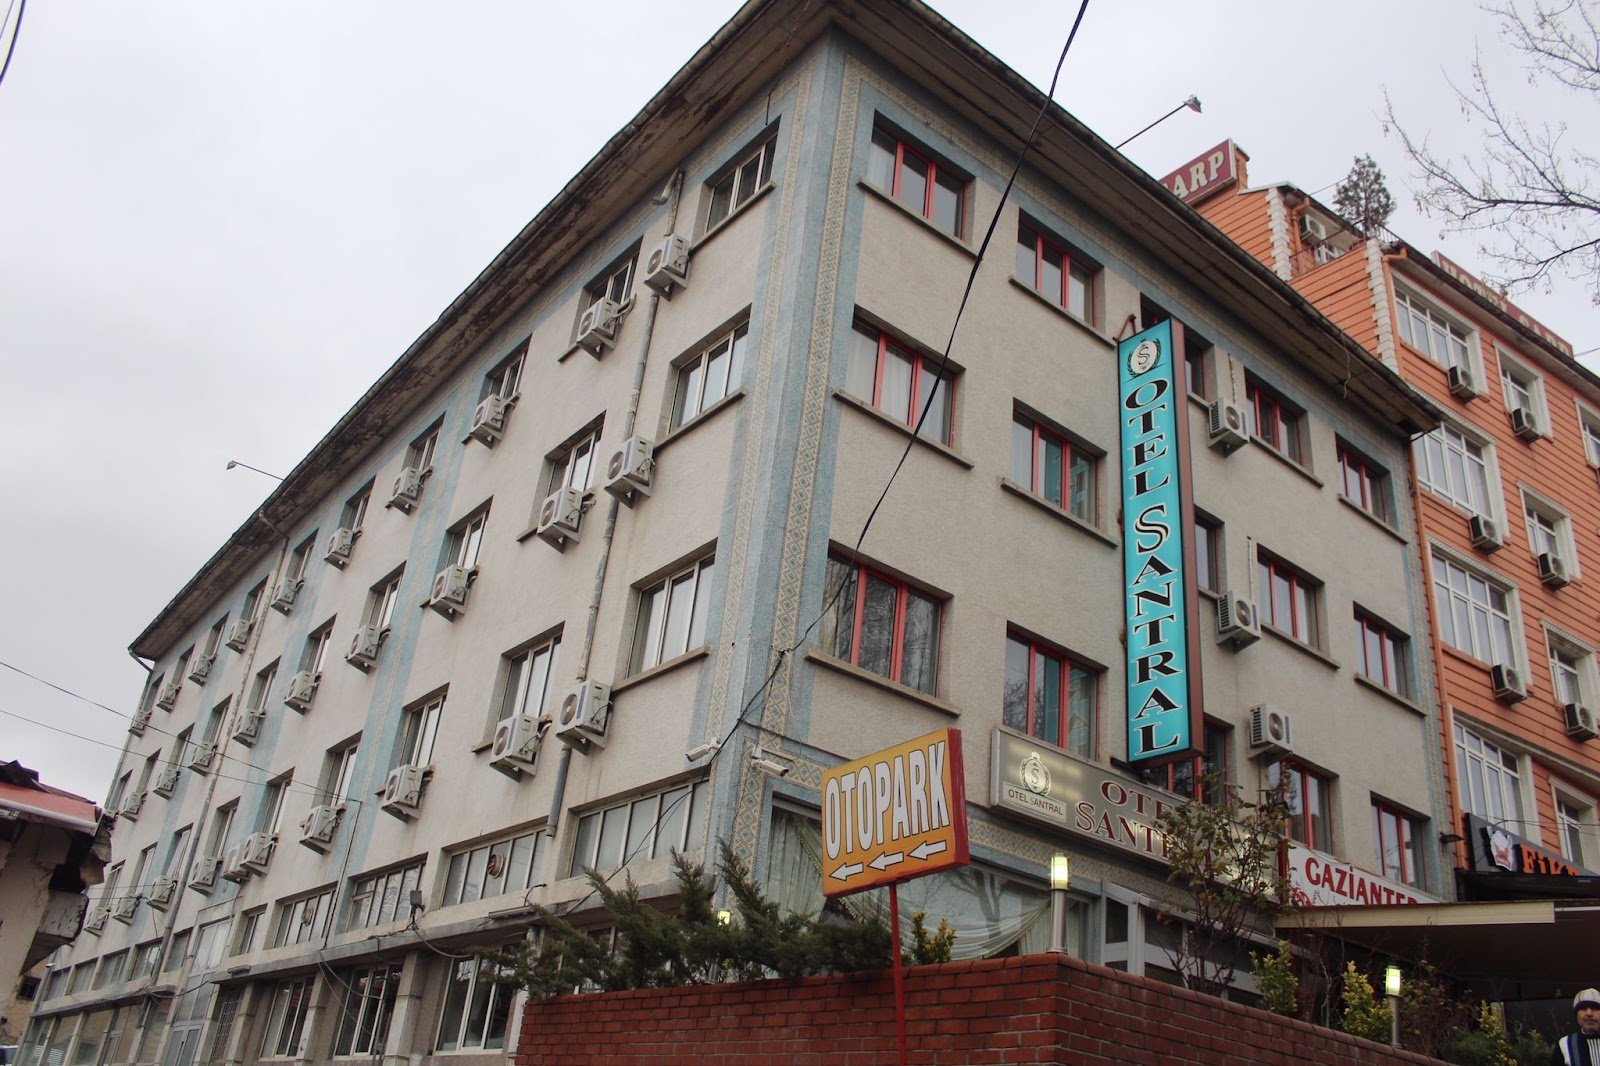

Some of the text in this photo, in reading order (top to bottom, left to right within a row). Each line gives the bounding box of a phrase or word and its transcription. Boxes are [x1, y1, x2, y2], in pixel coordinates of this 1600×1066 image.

[1163, 150, 1225, 199] ARP
[1124, 378, 1184, 756] OTEL SANTRAL
[825, 740, 950, 861] OTOPARK
[1008, 789, 1029, 804] OTEL
